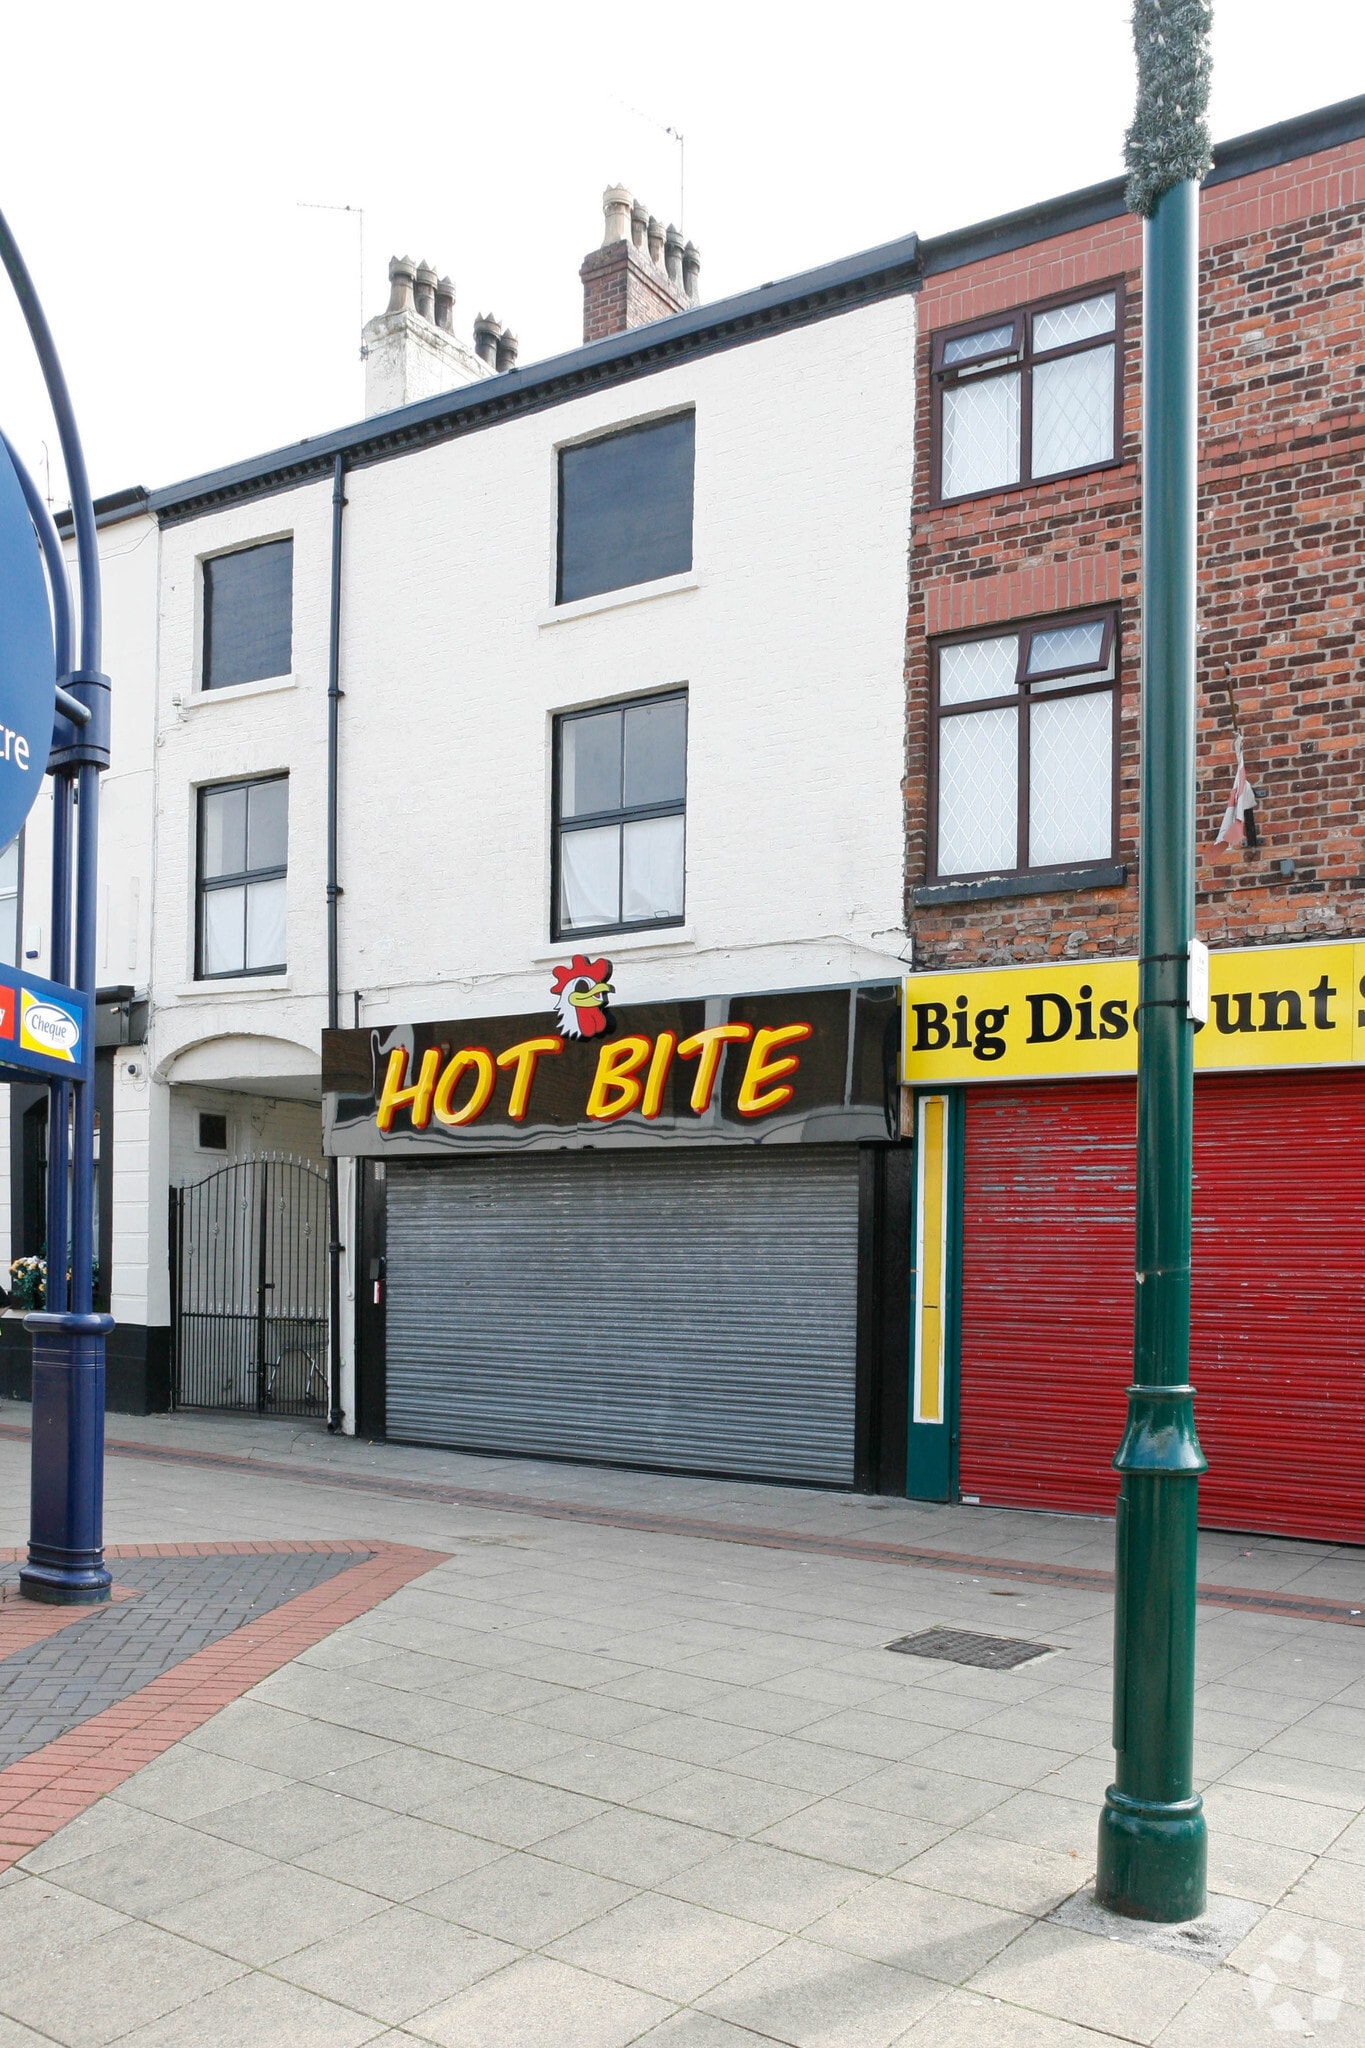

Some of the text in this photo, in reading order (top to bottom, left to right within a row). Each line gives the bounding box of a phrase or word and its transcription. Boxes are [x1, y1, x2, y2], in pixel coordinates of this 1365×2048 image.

[31, 1014, 67, 1040] Cheque
[912, 995, 1010, 1061] Big
[1026, 975, 1337, 1044] Disunt
[376, 1021, 813, 1133] HOT BITE
